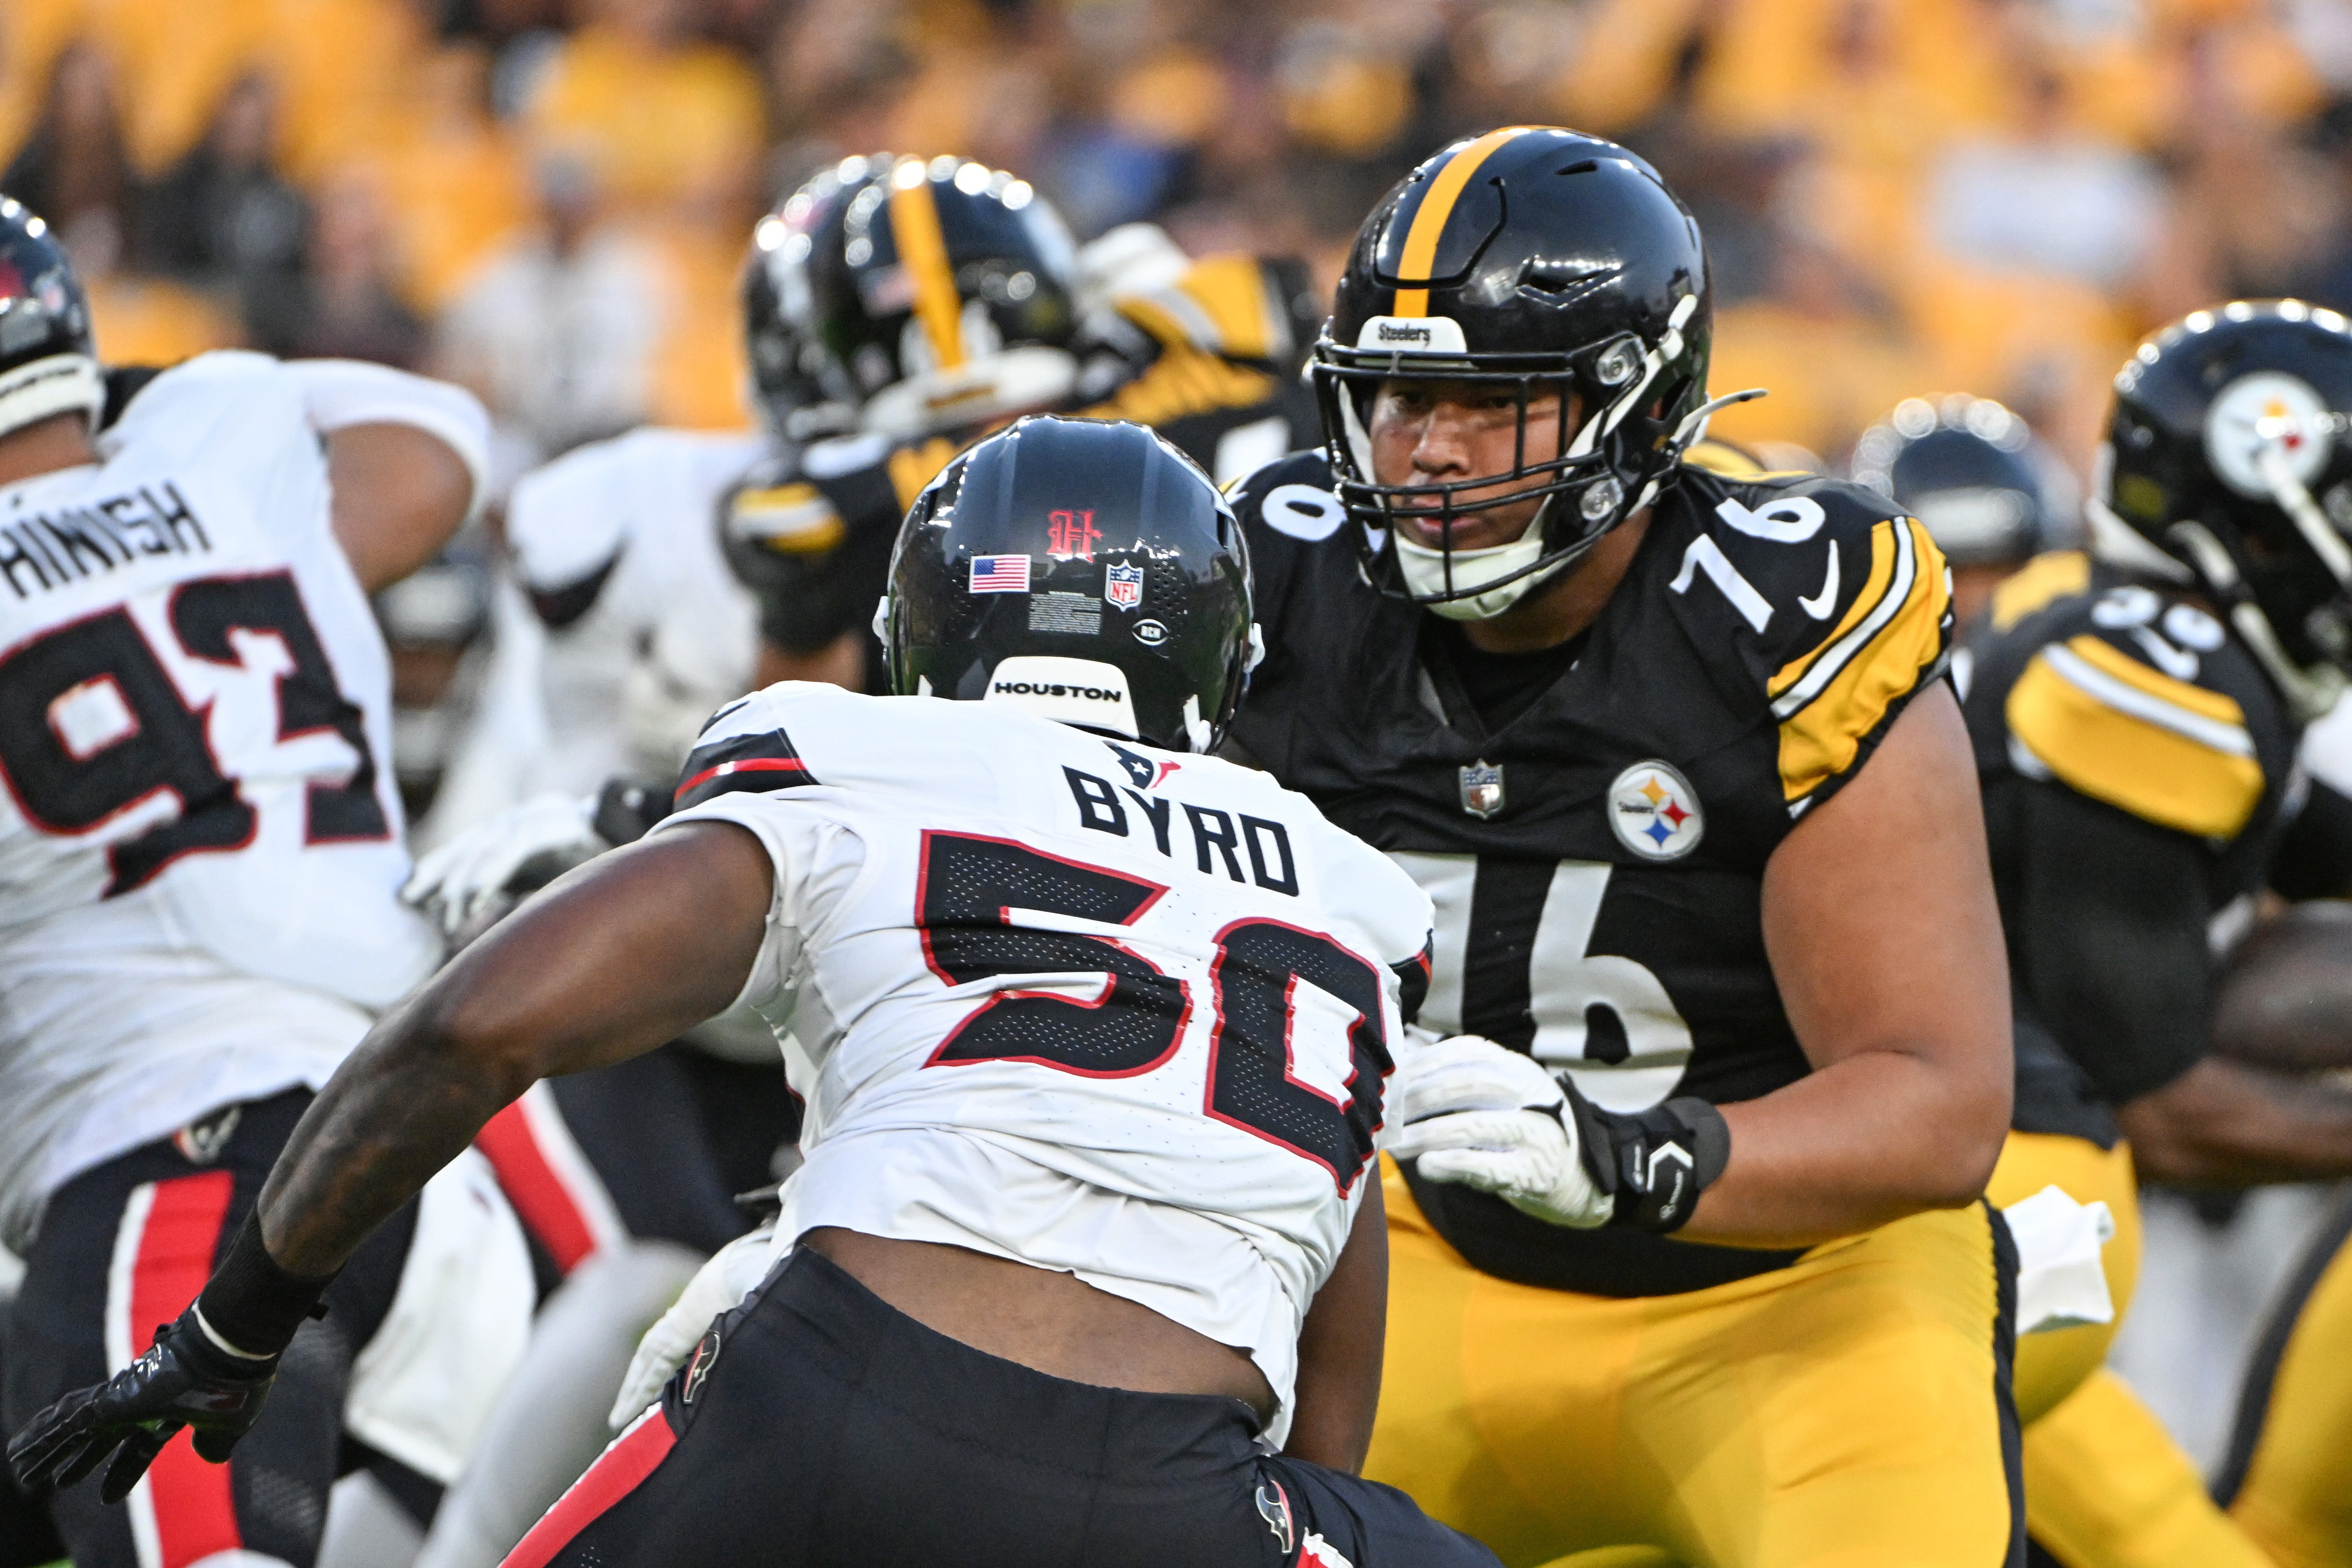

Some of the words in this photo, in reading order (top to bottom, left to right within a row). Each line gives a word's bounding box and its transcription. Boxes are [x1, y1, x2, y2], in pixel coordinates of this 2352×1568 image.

[1378, 322, 1431, 347] Steelers
[0, 478, 213, 599] HINISH
[1111, 582, 1138, 602] NFL
[1668, 496, 1826, 635] 76
[0, 567, 393, 901] 93
[994, 682, 1121, 702] HOUSTON
[1061, 764, 1299, 897] BYRD
[914, 828, 1396, 1200] 50
